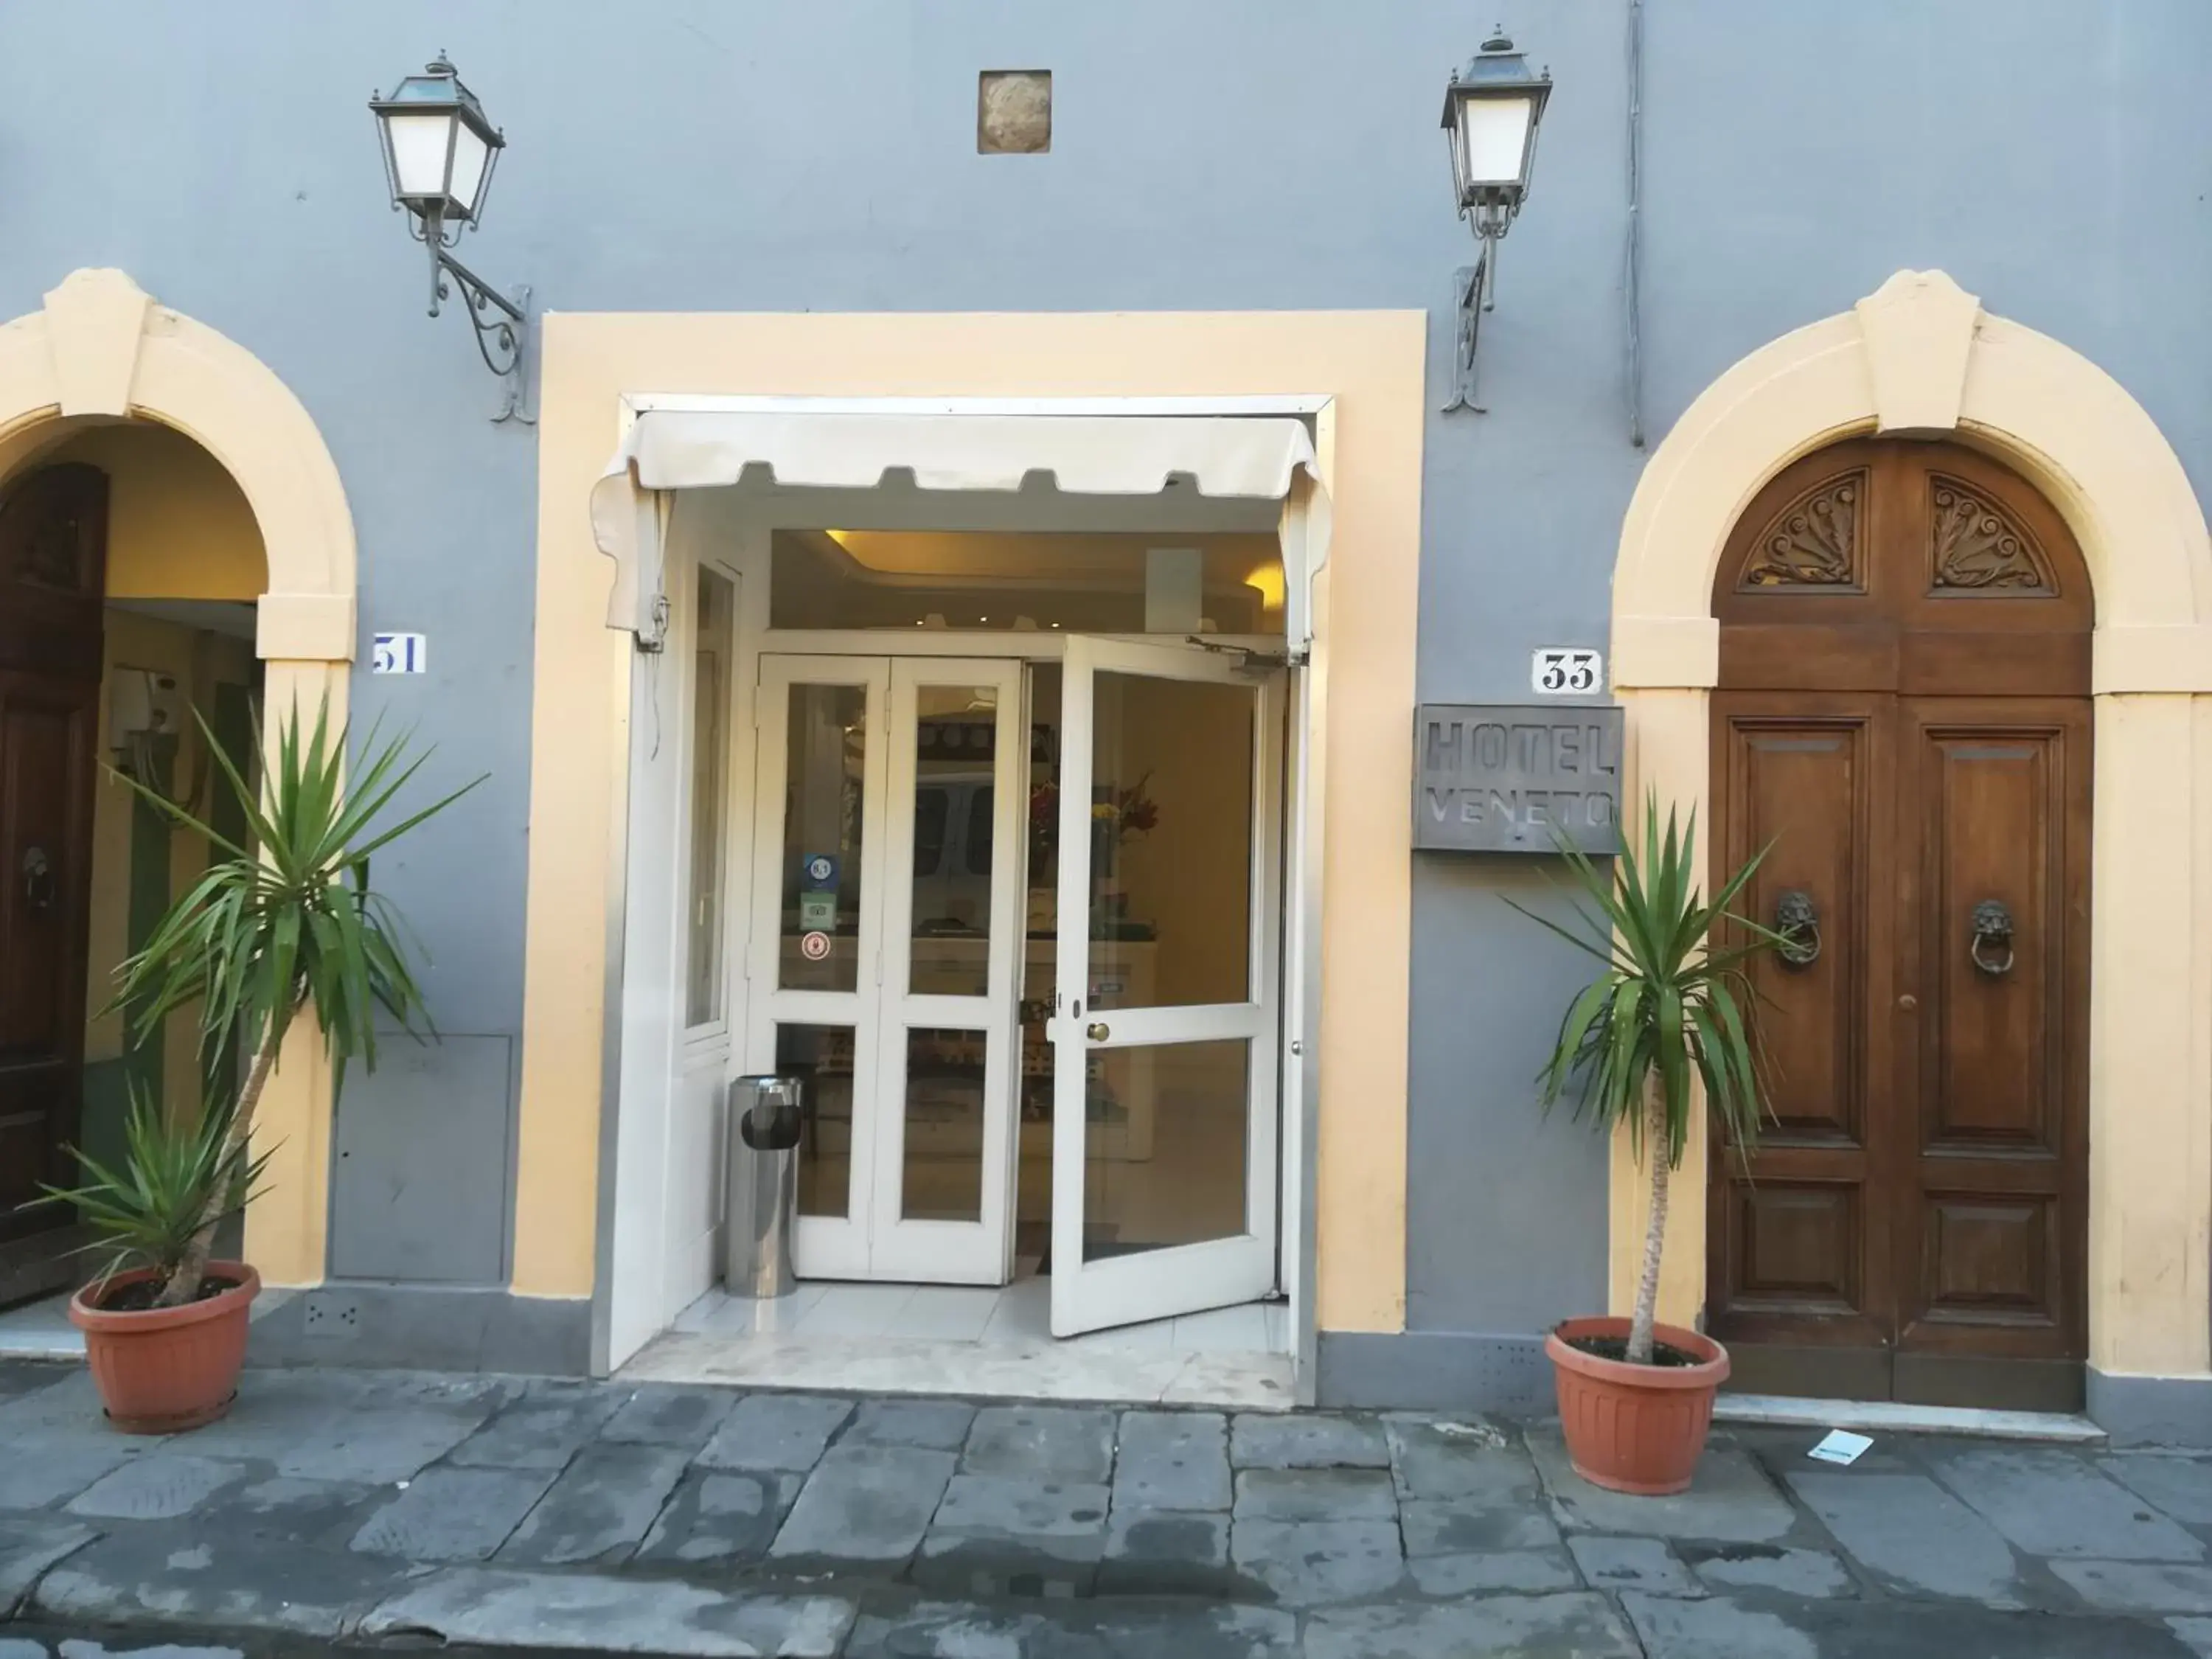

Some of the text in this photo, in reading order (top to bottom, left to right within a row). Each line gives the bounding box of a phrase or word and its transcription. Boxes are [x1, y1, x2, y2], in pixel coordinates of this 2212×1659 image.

[1543, 654, 1593, 689] 33
[1426, 722, 1614, 774] HOTEL
[1425, 787, 1613, 826] VENETO
